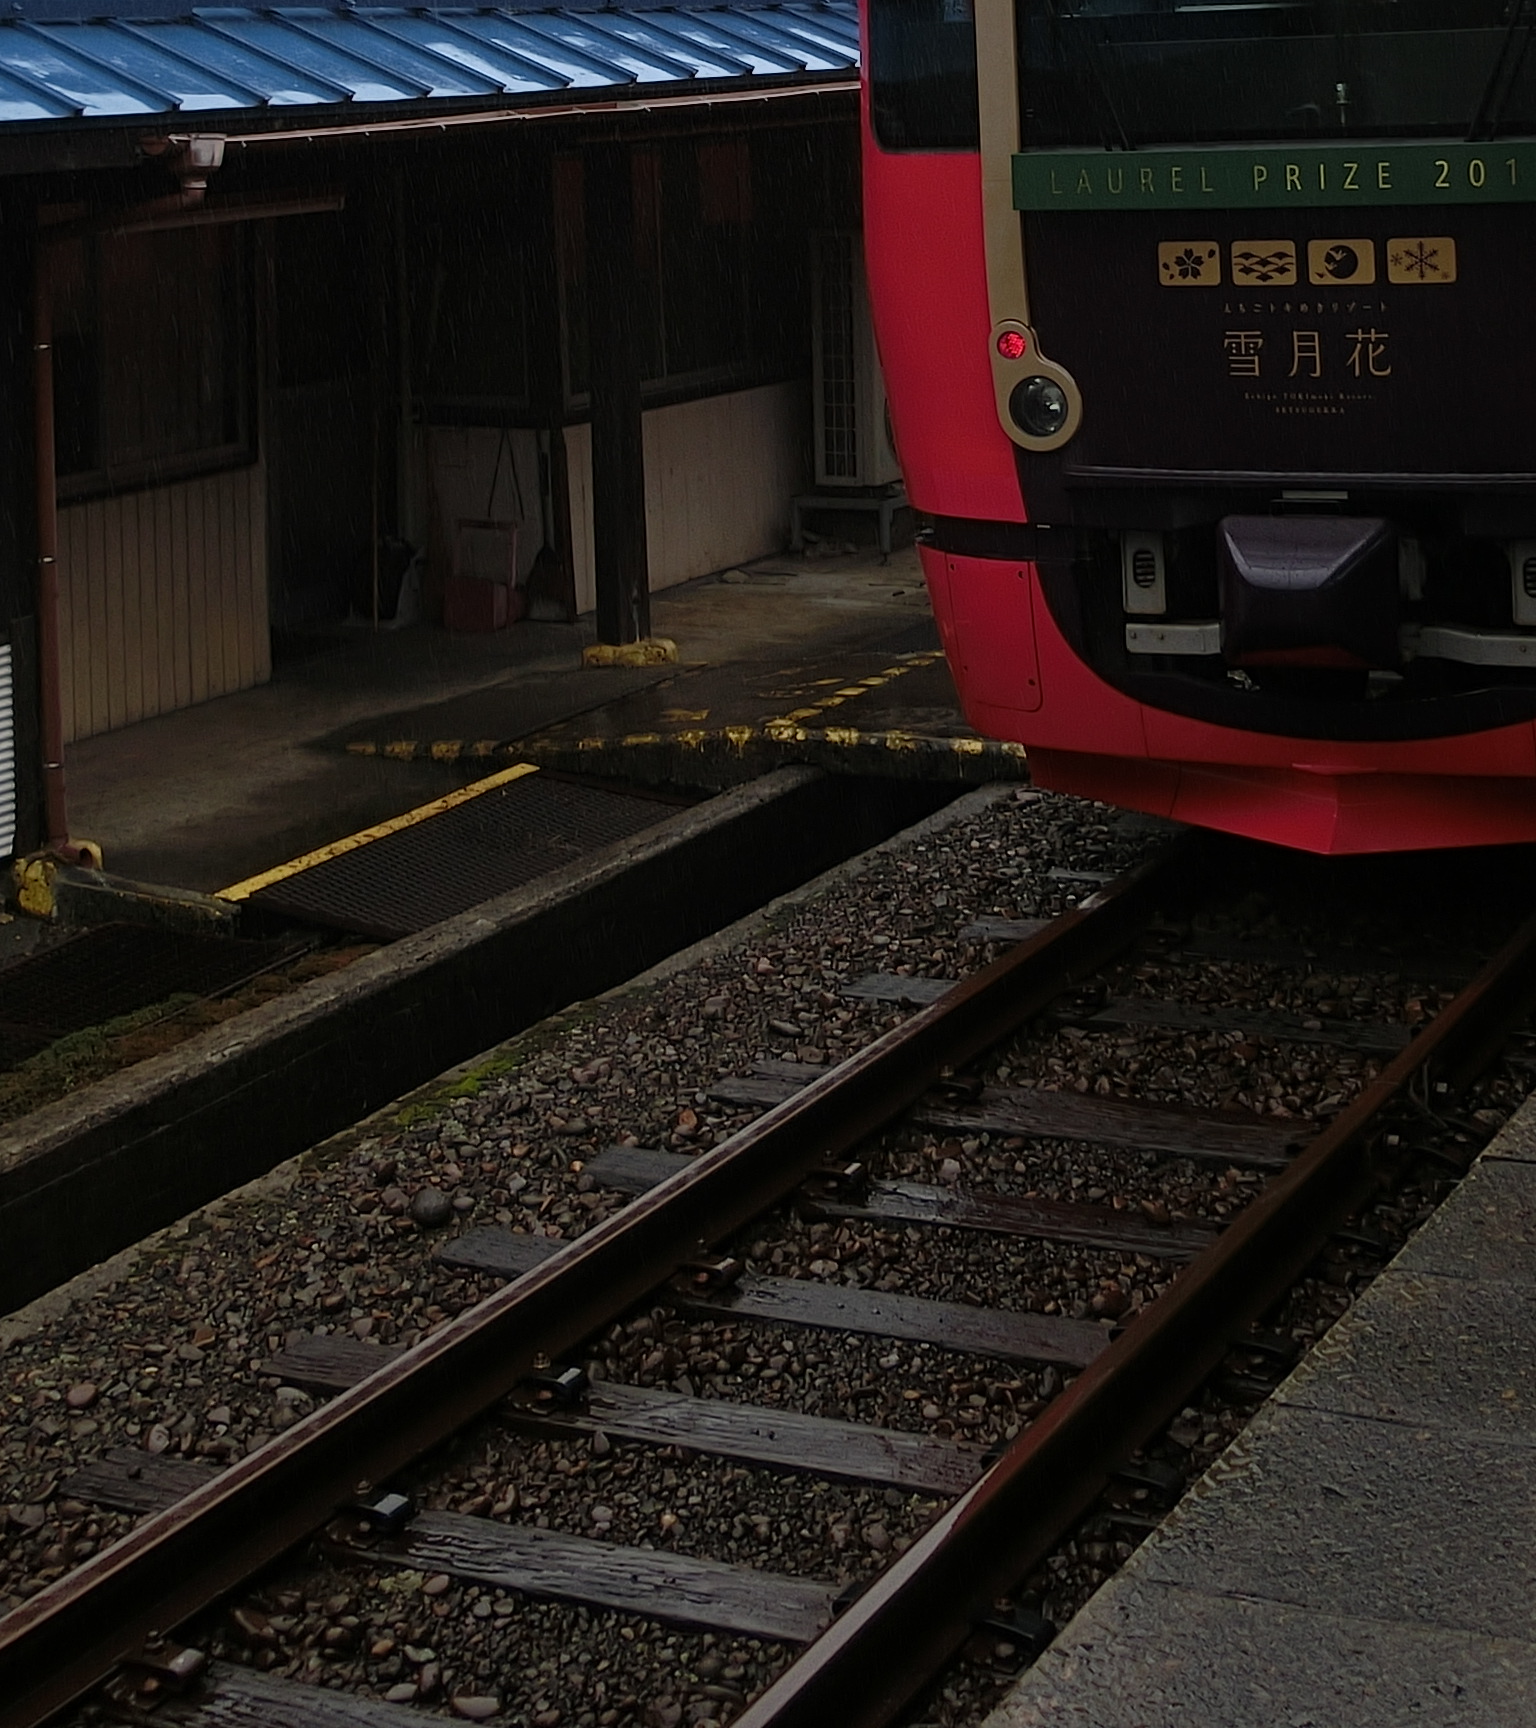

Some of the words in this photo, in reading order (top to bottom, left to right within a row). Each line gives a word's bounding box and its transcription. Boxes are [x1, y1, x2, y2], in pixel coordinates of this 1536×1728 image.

[1049, 166, 1215, 196] LAUREL
[1252, 162, 1393, 191] PRIZE
[1224, 328, 1392, 377] 雪月花
